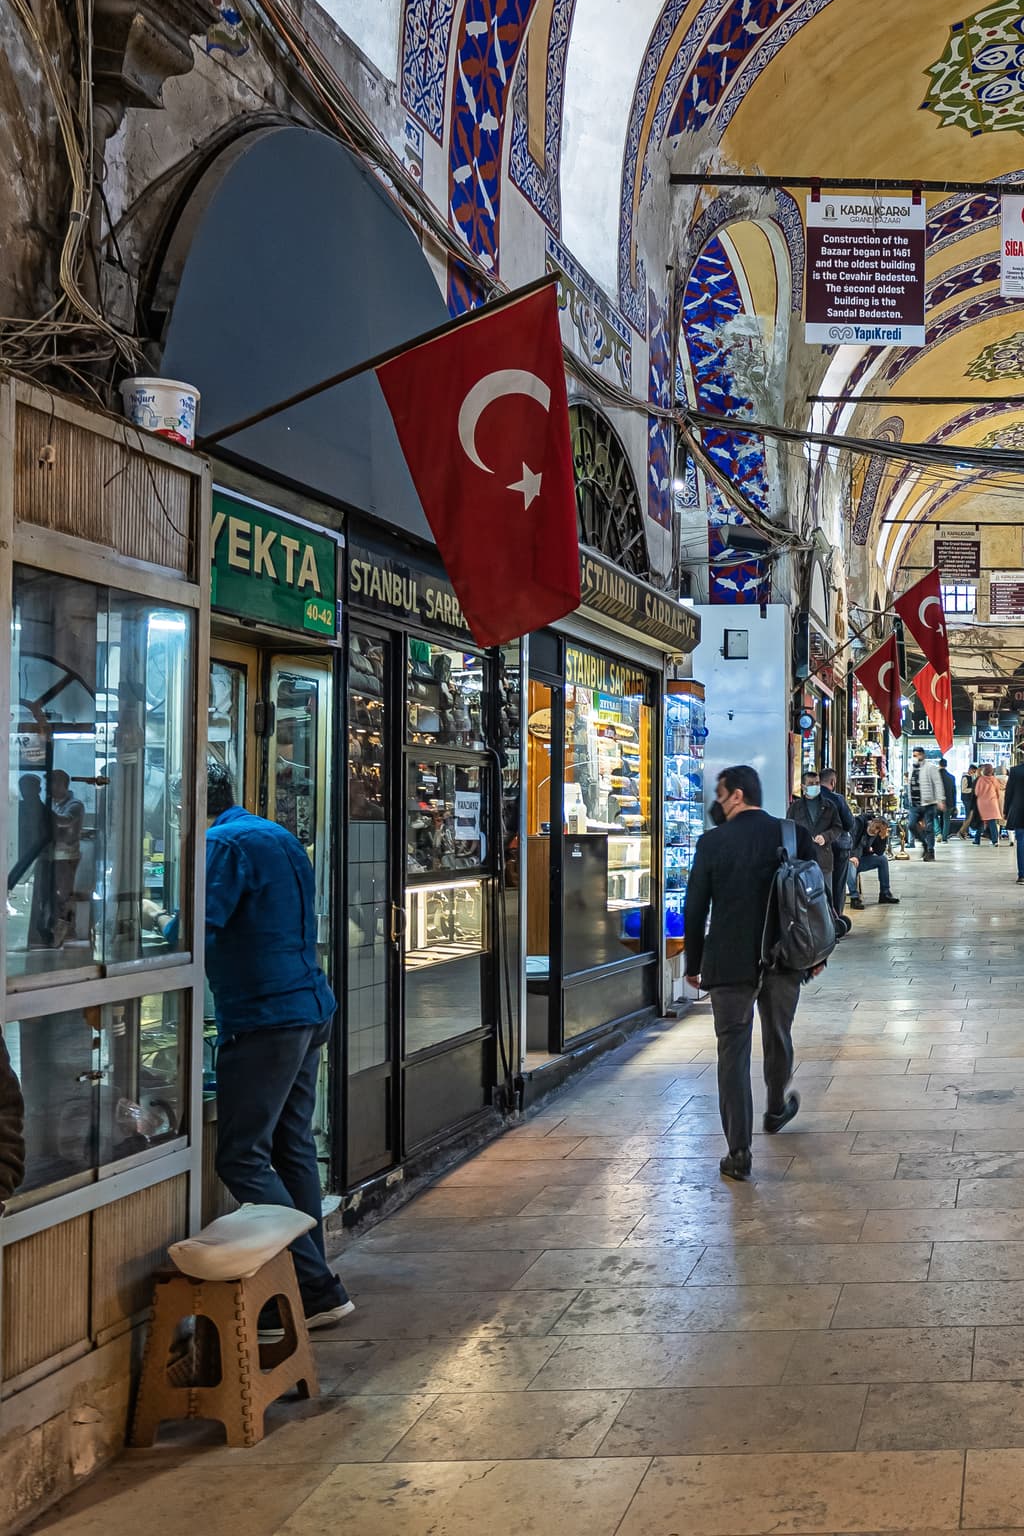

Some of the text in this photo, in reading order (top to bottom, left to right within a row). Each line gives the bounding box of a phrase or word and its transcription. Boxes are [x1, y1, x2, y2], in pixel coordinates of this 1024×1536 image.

[850, 216, 872, 224] GRAND
[823, 234, 908, 245] Construction of the
[820, 247, 911, 258] Bazaar began in 1461
[816, 259, 916, 272] and the oldest building
[812, 271, 918, 282] is the Cevahir Bedesten.
[826, 284, 905, 294] The second oldest
[834, 296, 896, 308] building is the
[827, 308, 903, 319] Sandal Bedesten.
[854, 326, 902, 341] YapıKredi
[210, 512, 321, 593] YEKTA
[350, 558, 420, 614] STANBUL
[306, 603, 332, 626] 40-42
[565, 648, 608, 692] STANBUL
[978, 730, 1010, 740] ROLAN
